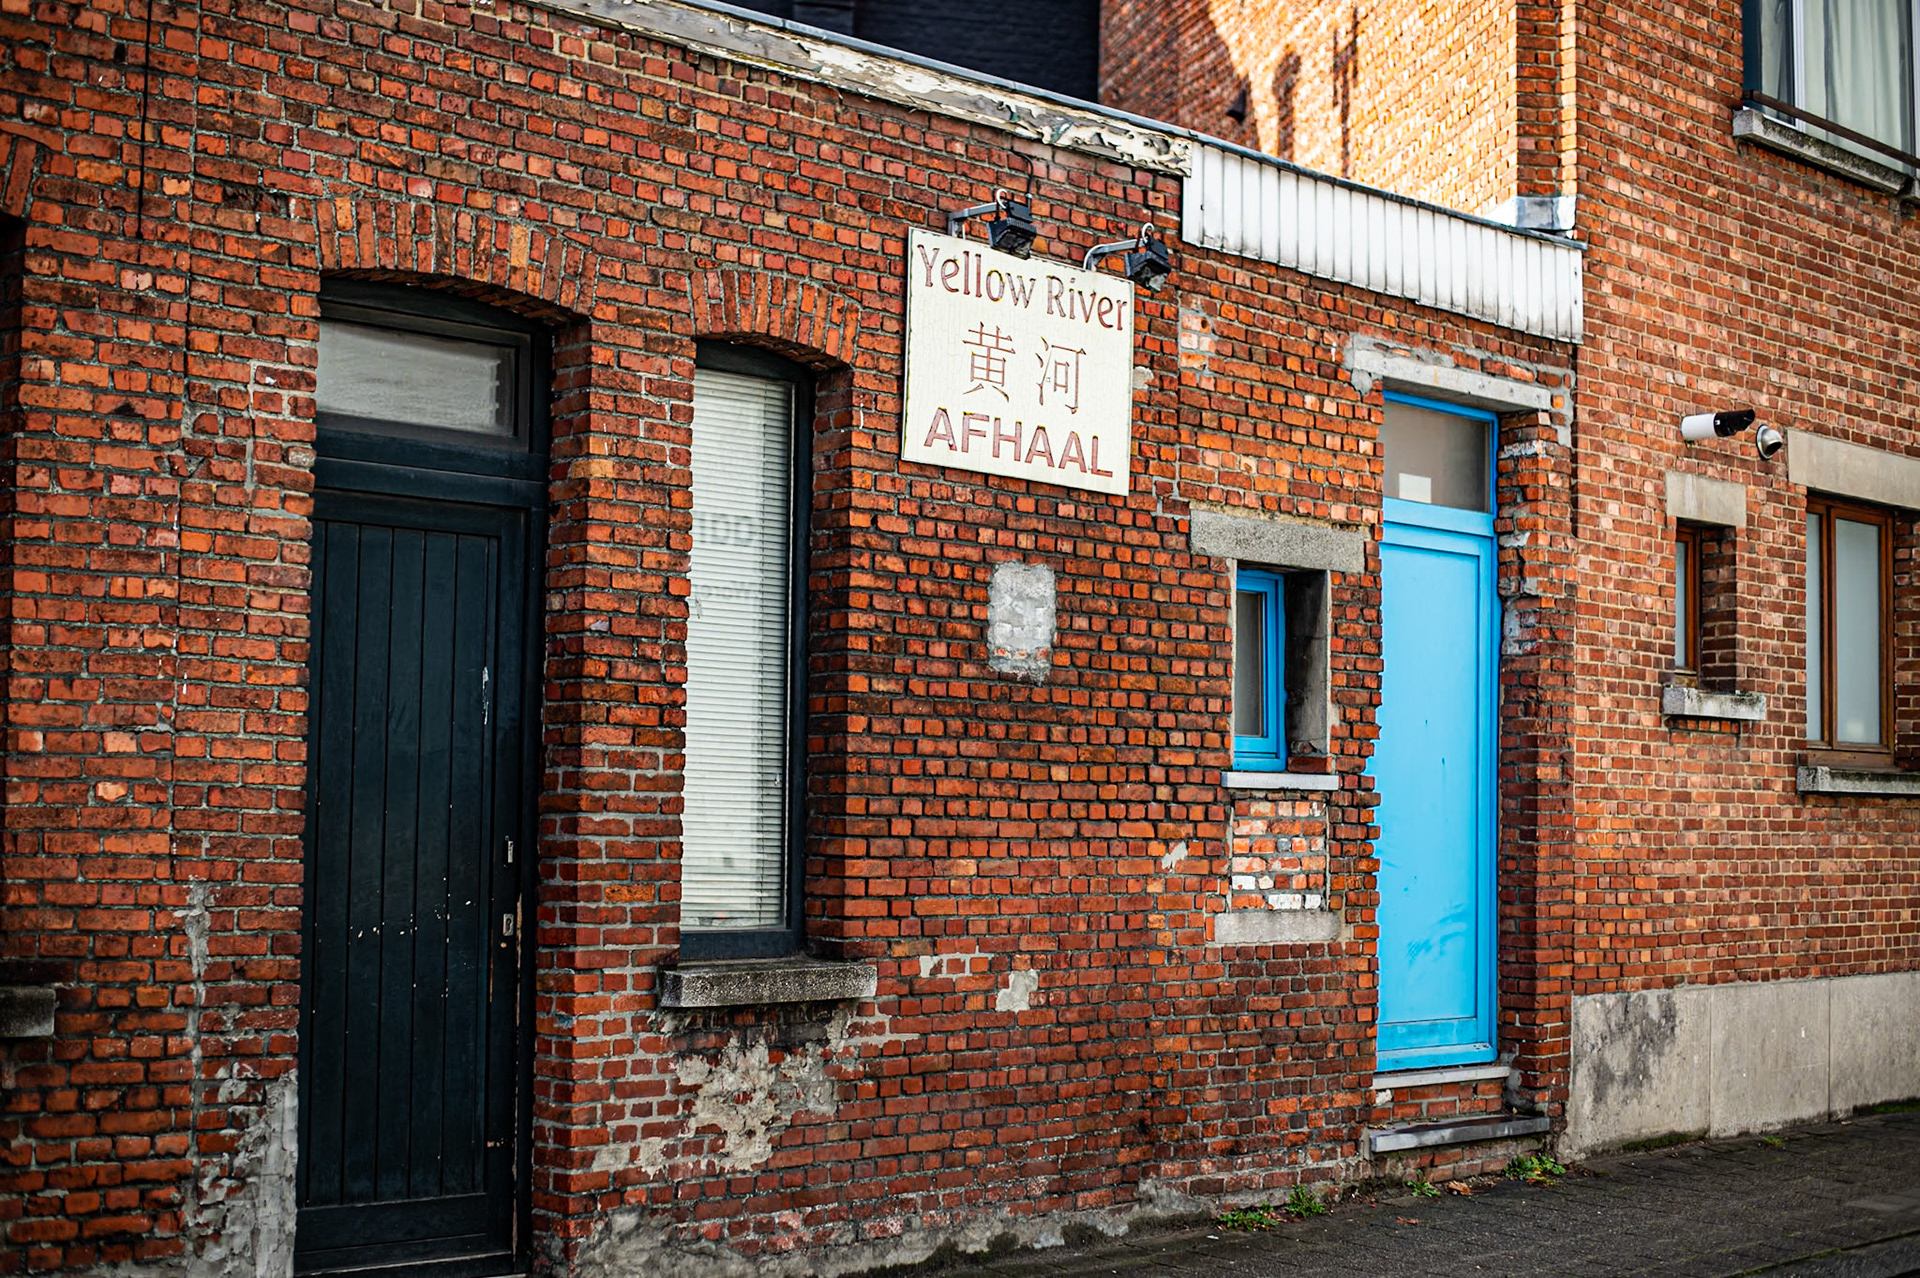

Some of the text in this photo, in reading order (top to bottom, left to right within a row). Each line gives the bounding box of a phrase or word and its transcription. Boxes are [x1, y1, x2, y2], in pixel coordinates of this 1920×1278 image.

[917, 244, 1127, 331] Yellow River
[962, 321, 1087, 415] 黄河
[923, 407, 1113, 478] AFHAAL
